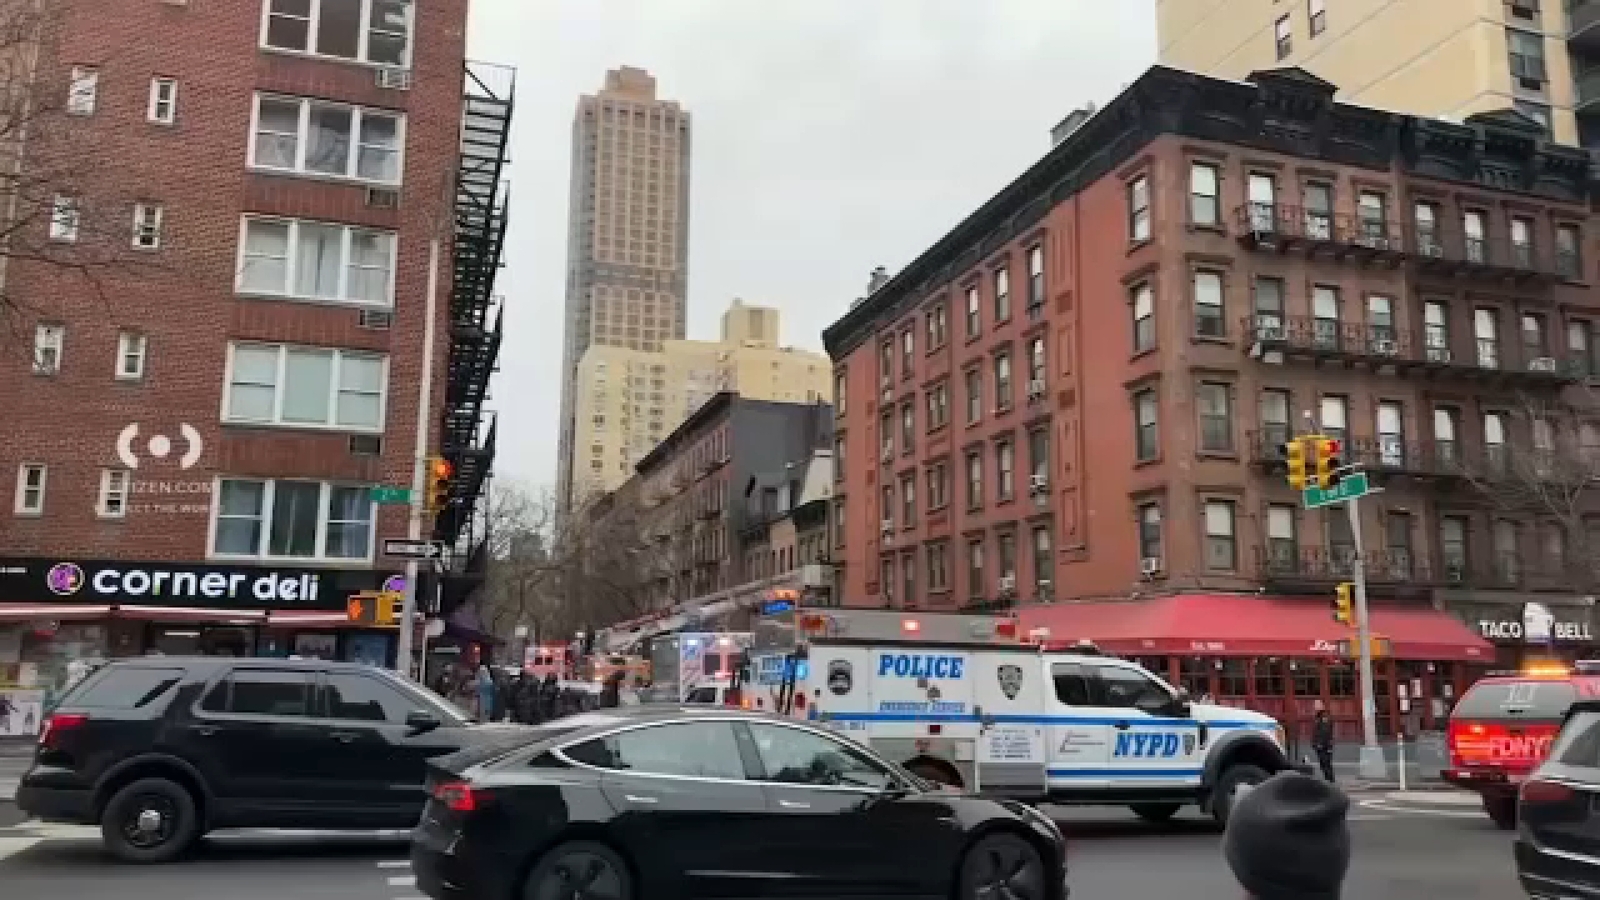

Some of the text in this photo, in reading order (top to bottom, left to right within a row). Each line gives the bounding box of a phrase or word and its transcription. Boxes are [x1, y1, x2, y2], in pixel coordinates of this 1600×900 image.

[92, 569, 319, 601] corner deli
[1479, 620, 1593, 640] TACO BELL
[878, 654, 964, 679] POLICE
[1112, 732, 1179, 758] NYPD
